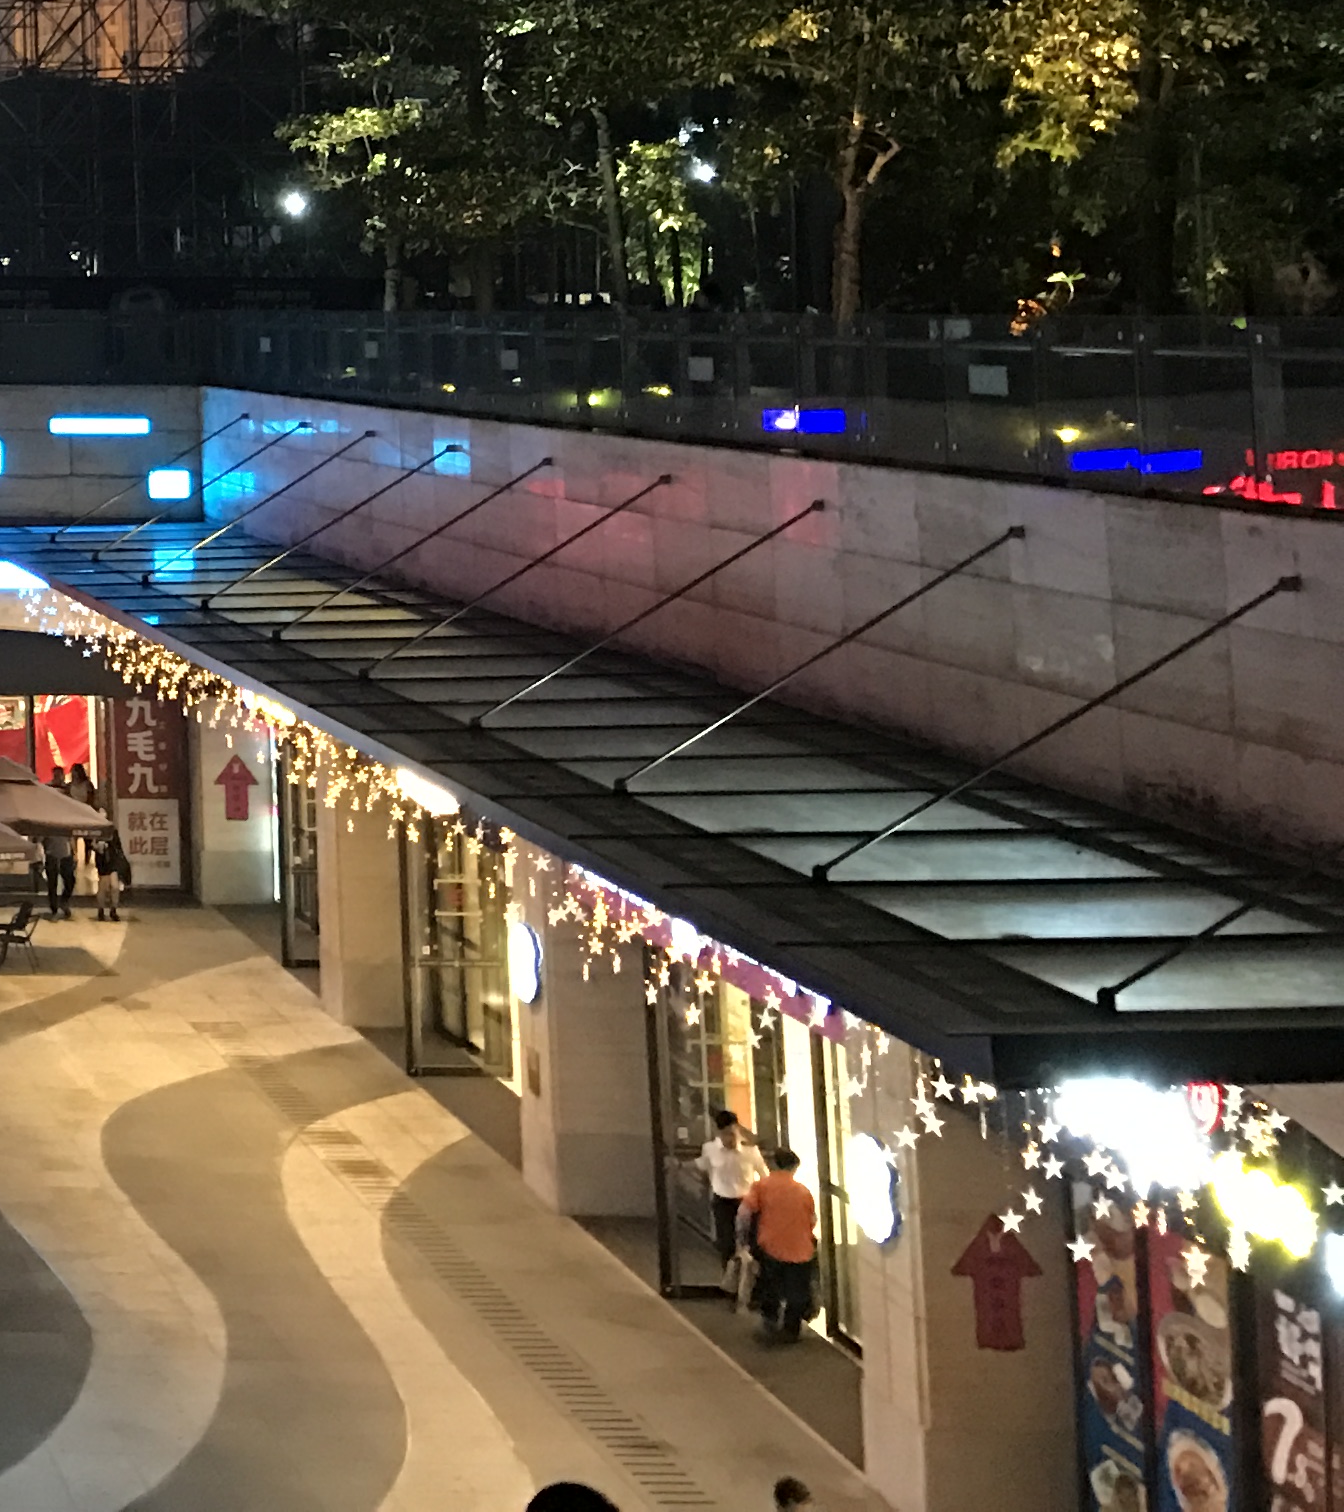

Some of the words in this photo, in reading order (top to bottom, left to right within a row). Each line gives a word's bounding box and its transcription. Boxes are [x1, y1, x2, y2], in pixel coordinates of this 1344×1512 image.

[125, 696, 159, 794] 九毛九
[127, 811, 169, 832] 就在
[128, 837, 169, 856] 此层
